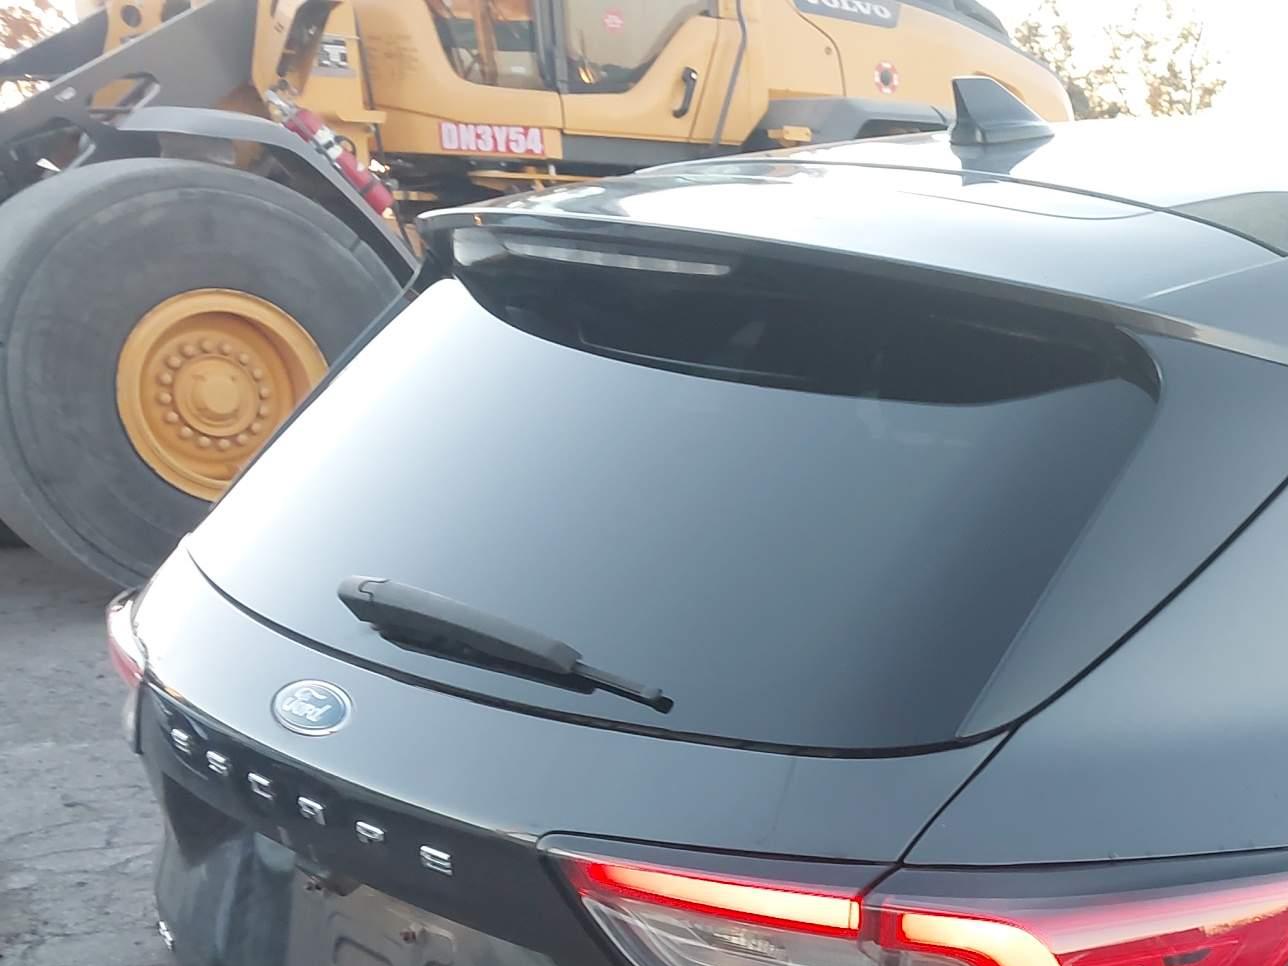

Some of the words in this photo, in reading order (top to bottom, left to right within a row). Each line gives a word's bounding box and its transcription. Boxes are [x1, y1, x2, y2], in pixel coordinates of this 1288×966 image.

[440, 121, 544, 154] DN3Y54
[281, 687, 333, 722] Ford
[170, 728, 453, 876] ESCAPE
